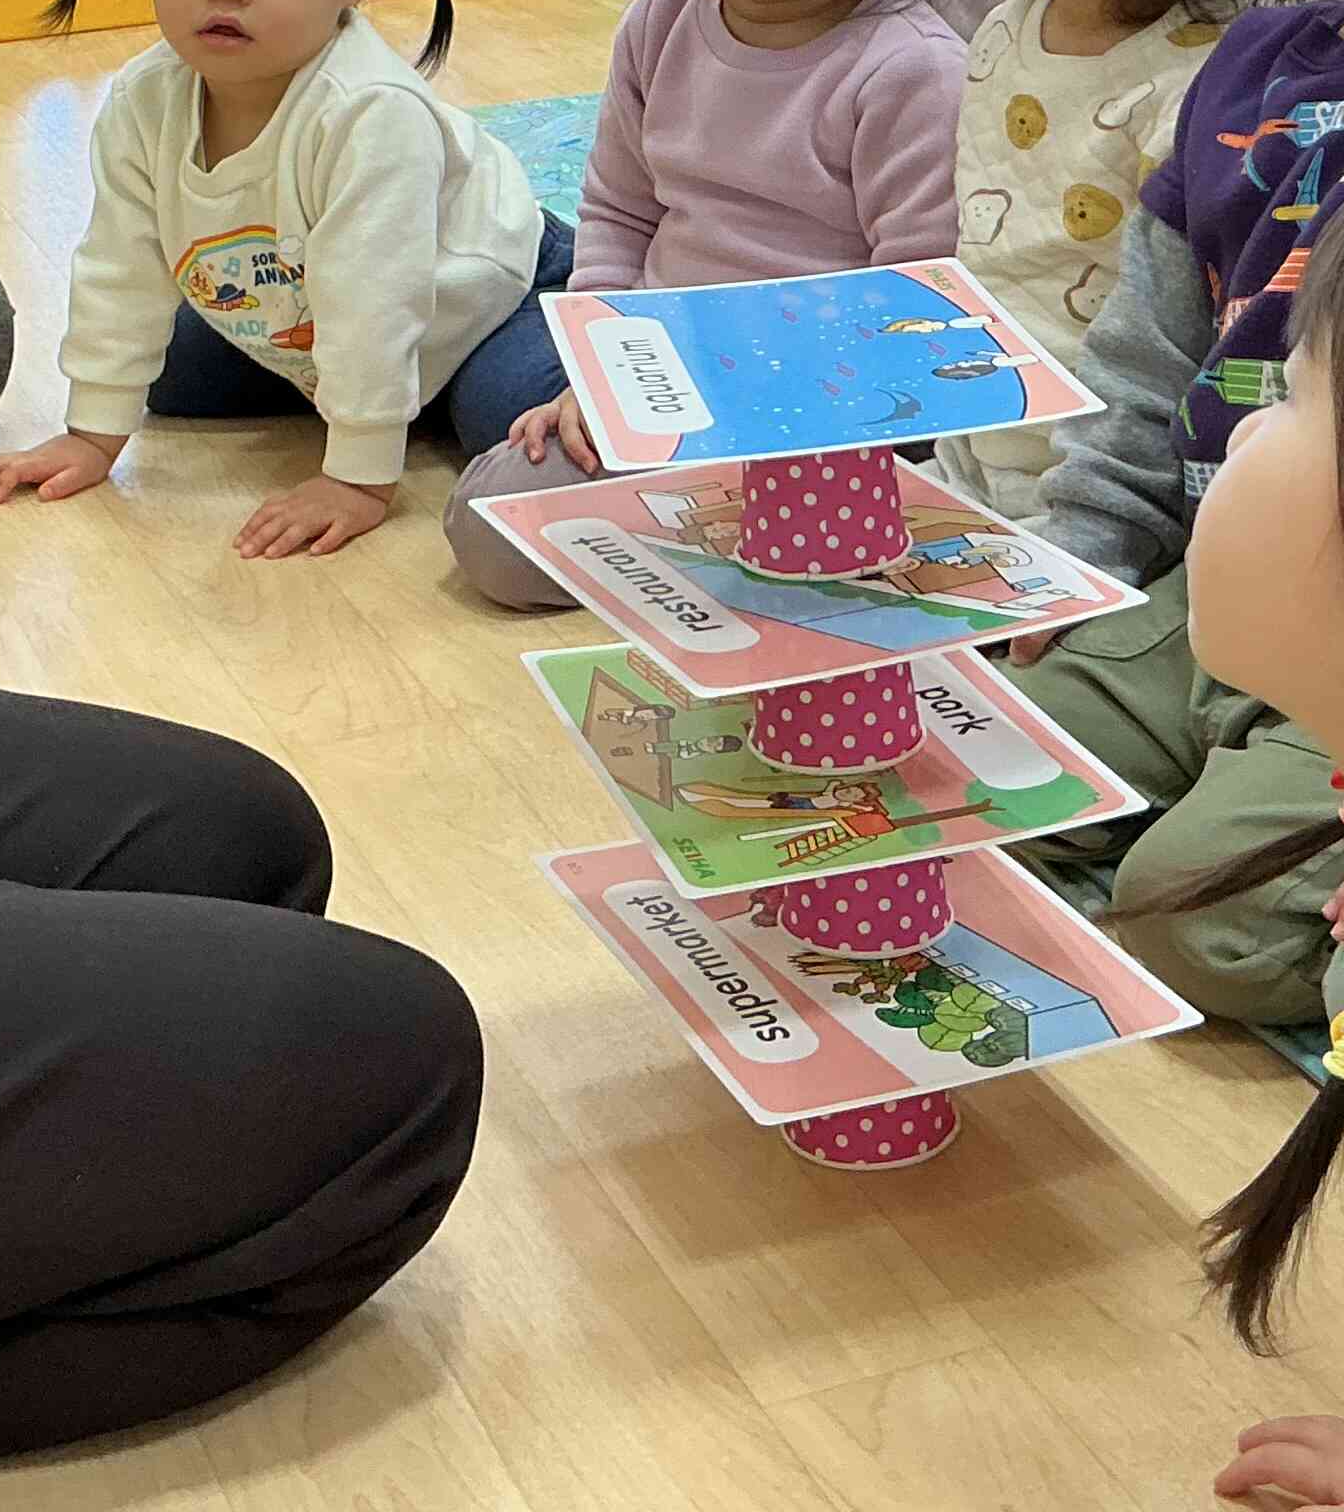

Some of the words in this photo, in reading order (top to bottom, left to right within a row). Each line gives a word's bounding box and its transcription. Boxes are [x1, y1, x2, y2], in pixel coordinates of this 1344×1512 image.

[619, 338, 686, 415] aquarium
[572, 535, 722, 634] restaurant
[916, 685, 989, 736] park
[672, 836, 718, 879] SEIHA
[625, 893, 790, 1045] supermarket
